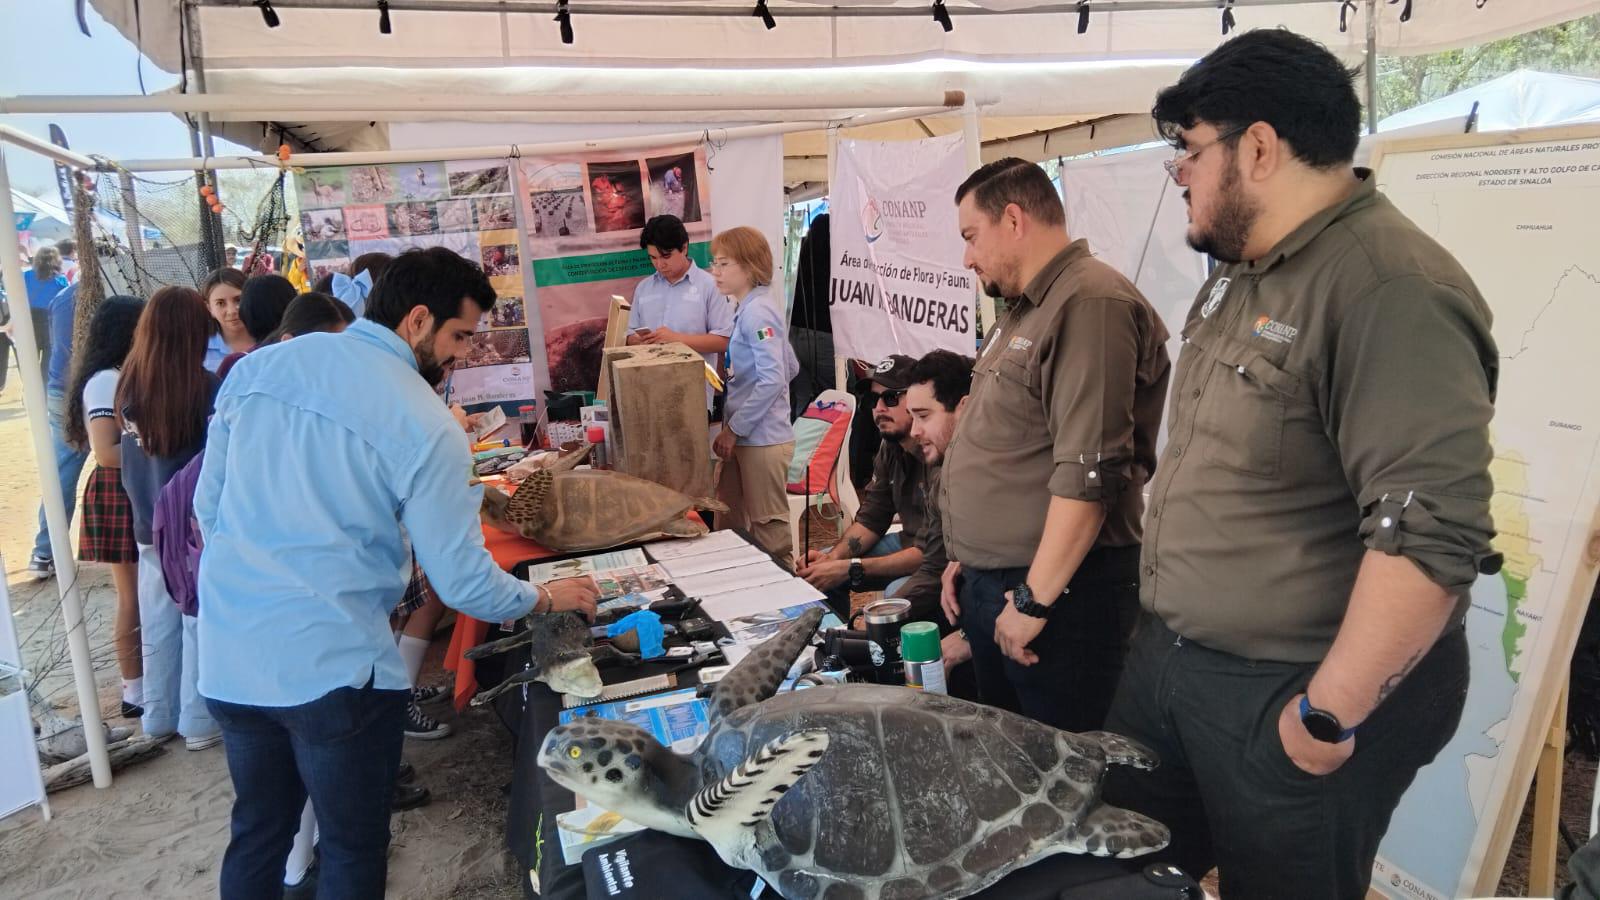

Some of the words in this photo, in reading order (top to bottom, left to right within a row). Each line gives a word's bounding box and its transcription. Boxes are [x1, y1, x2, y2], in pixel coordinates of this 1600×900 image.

[1463, 150, 1497, 158] NACIONAL
[1535, 143, 1580, 153] NATURALES
[1581, 142, 1600, 150] PRO
[1484, 168, 1521, 176] NOROESTE
[1478, 178, 1506, 186] ESTADO
[1519, 177, 1552, 185] SINALOA
[882, 200, 926, 218] CONANP
[840, 251, 861, 268] Área
[899, 266, 911, 281] de
[913, 268, 934, 284] Flora
[936, 273, 941, 289] y
[942, 271, 970, 289] Fauna
[829, 278, 875, 307] JUAN
[1549, 421, 1582, 431] DURANGO
[1516, 609, 1543, 621] NAYARIT
[598, 853, 621, 895] Ambiental
